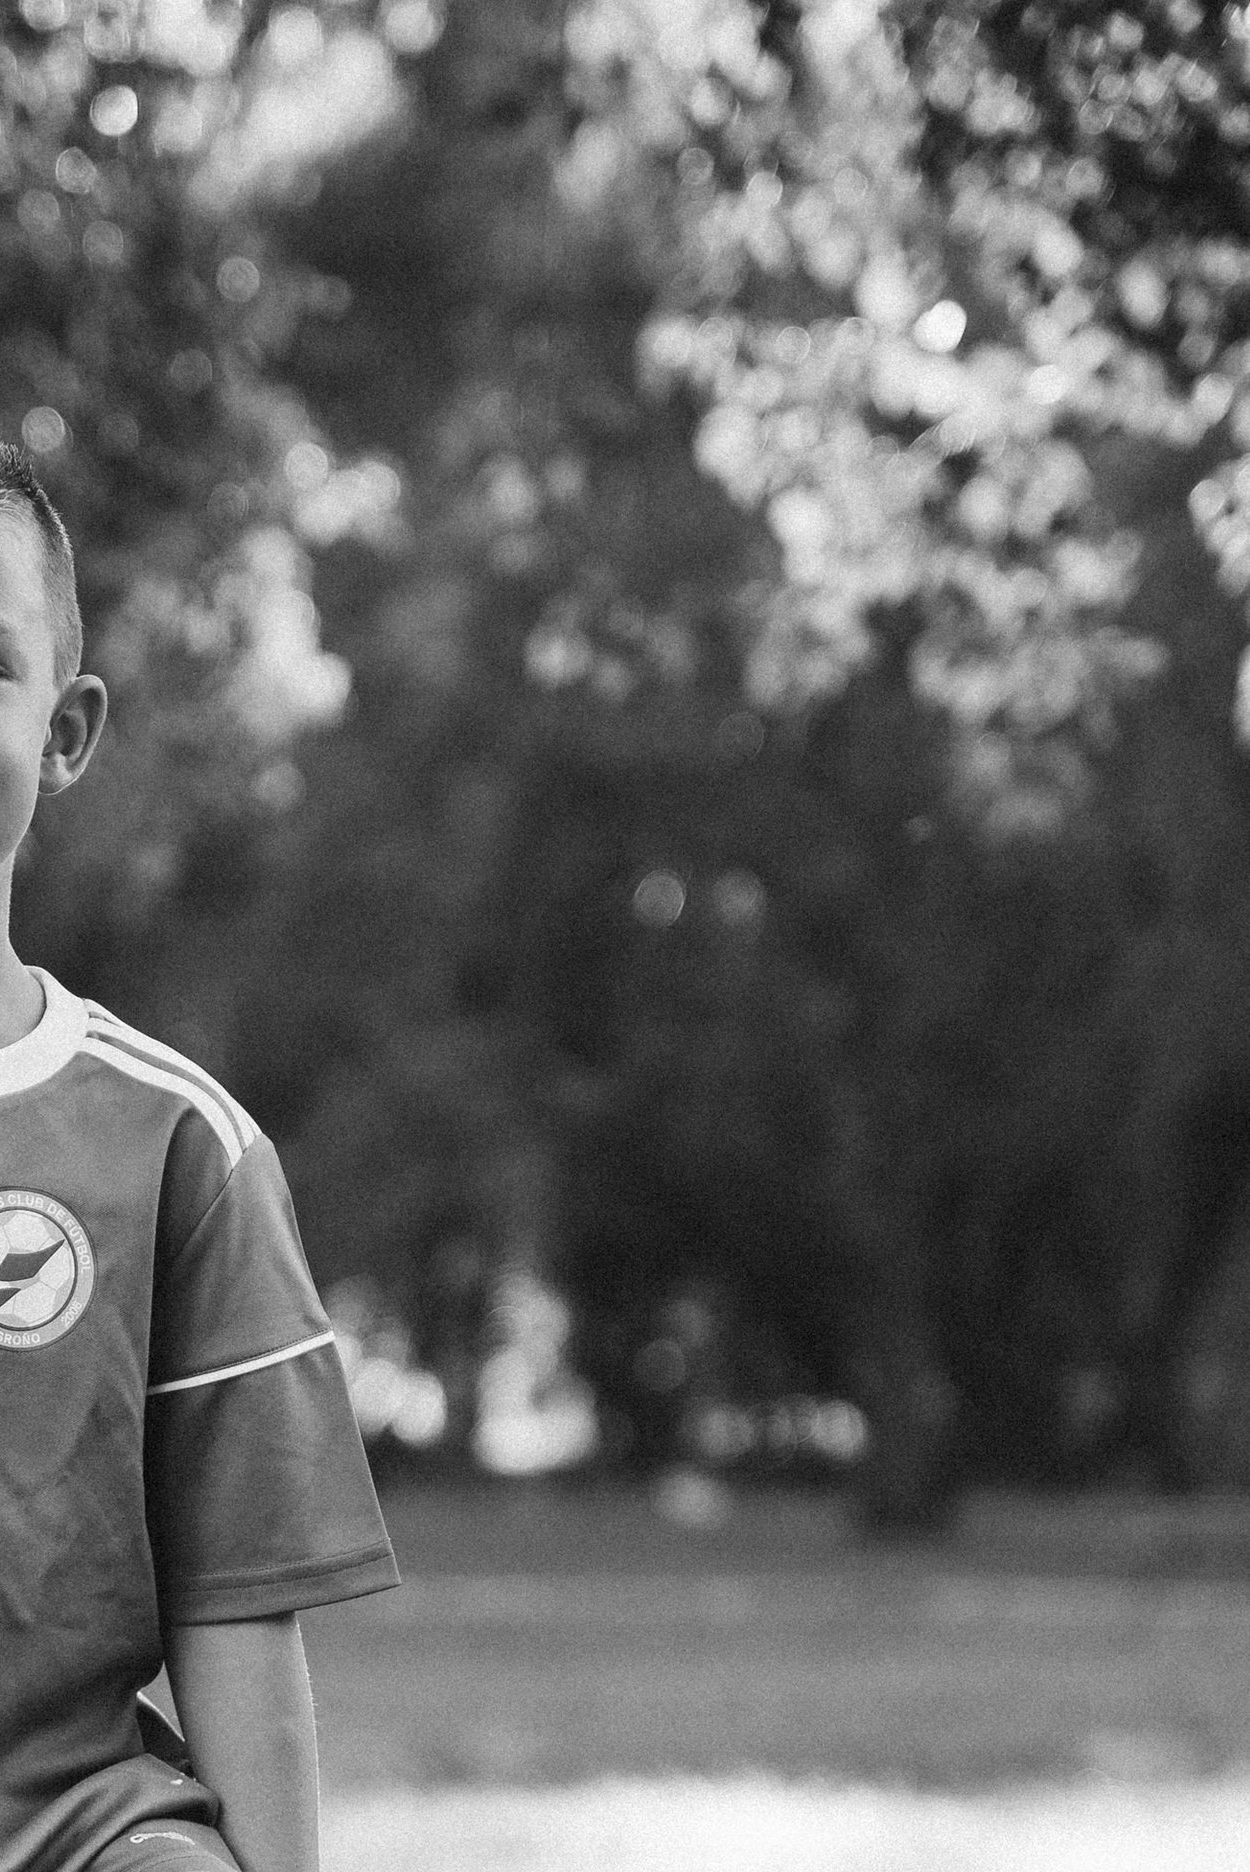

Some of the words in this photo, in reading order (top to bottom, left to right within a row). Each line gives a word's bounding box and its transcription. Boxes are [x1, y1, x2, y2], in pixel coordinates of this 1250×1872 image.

[7, 1194, 44, 1210] CLUB
[46, 1203, 66, 1221] DE
[63, 1218, 92, 1273] FÚTBOL
